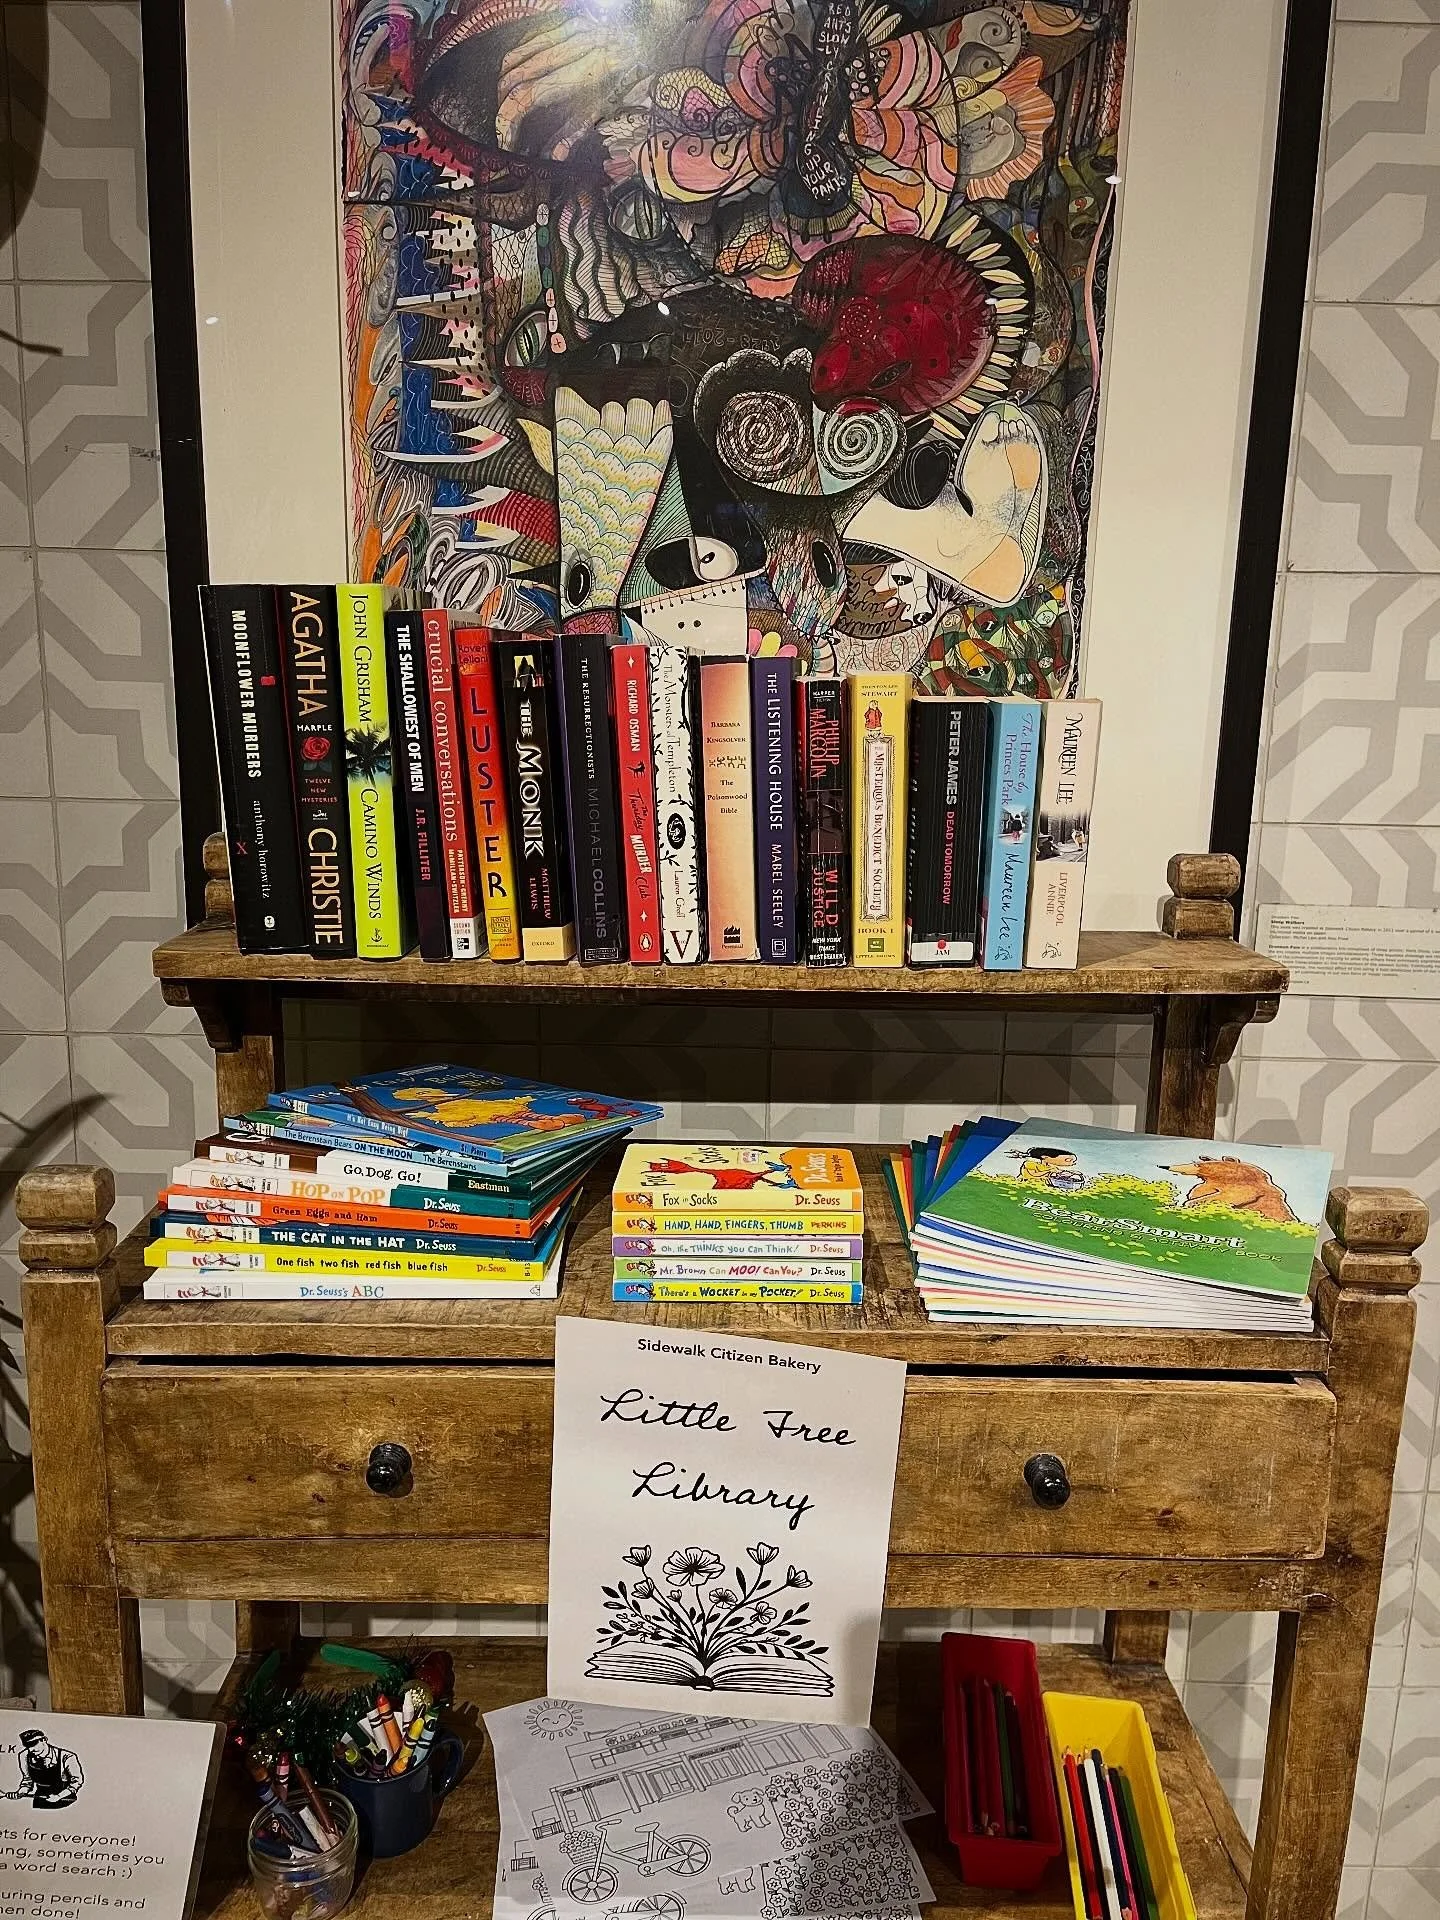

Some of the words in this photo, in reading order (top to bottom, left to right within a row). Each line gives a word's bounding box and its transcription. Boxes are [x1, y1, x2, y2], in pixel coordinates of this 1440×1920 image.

[348, 594, 369, 639] JOHN
[289, 591, 328, 716] AGATHA
[396, 625, 412, 651] THE
[426, 619, 452, 693] crucial
[231, 609, 255, 708] MOONFLOWER
[580, 657, 589, 679] THE
[353, 645, 373, 722] GRISHAM
[398, 653, 420, 742] SHALLOWEST
[626, 678, 639, 715] RICHARD
[767, 672, 778, 694] THE
[296, 724, 333, 732] MARPLE
[519, 698, 533, 738] THE
[582, 681, 595, 780] RESURRECTIONISTS
[629, 717, 641, 752] OSMAN
[767, 698, 782, 775] LISTENING
[948, 710, 962, 757] PETER
[242, 712, 262, 778] MURDERS
[407, 742, 422, 760] OF
[810, 708, 827, 778] MARGOLIN
[826, 719, 840, 766] PHILIP
[1003, 733, 1018, 777] Princes
[1018, 741, 1032, 780] House
[409, 762, 425, 792] MEN
[433, 700, 461, 842] conversations
[664, 737, 682, 793] Templeton
[946, 758, 959, 806] JAMES
[470, 686, 508, 898] LUSTER
[516, 737, 545, 860] MONK
[769, 781, 784, 831] HOUSE
[1001, 779, 1014, 805] Park
[253, 800, 266, 847] anthony
[360, 788, 379, 858] CAMINO
[415, 808, 426, 829] J.R.
[945, 811, 955, 843] DEAD
[418, 831, 431, 881] FILLITER
[630, 834, 653, 873] MURDER
[771, 843, 783, 884] MABEL
[258, 849, 272, 899] horowitz
[308, 828, 344, 944] CHRISTIE
[365, 862, 383, 919] WINDS
[673, 870, 684, 895] Lauren
[942, 844, 954, 905] TOMORROW
[999, 852, 1024, 912] Maureen
[592, 868, 607, 938] COLLINS
[772, 888, 784, 928] SEELEY
[813, 867, 825, 928] JUSTICE
[825, 869, 839, 928] WILD
[1055, 871, 1068, 927] LIVERPOOL
[999, 915, 1018, 940] Lee
[284, 1129, 298, 1140] The
[298, 1132, 333, 1145] Berenstain
[334, 1138, 352, 1149] Bears
[354, 1142, 367, 1152] ON
[368, 1145, 385, 1155] THE
[386, 1148, 413, 1160] MOON
[422, 1154, 436, 1164] The
[437, 1156, 477, 1171] Berenstains
[290, 1181, 330, 1200] HOP
[347, 1186, 386, 1204] POP
[423, 1198, 437, 1210] Dr.
[438, 1200, 461, 1213] Seuss
[343, 1164, 364, 1177] Go,
[365, 1166, 394, 1180] Dog.
[397, 1170, 422, 1183] Go!
[467, 1180, 510, 1193] Eastman
[272, 1205, 301, 1216] Green
[306, 1206, 331, 1219] Eggs
[334, 1210, 353, 1219] and
[355, 1213, 378, 1223] Ham
[427, 1218, 439, 1229] Dr.
[439, 1219, 459, 1230] Seuss
[662, 1192, 680, 1205] Fox
[689, 1192, 718, 1207] Socks
[794, 1194, 812, 1206] Dr.
[813, 1194, 841, 1206] Seuss
[271, 1231, 296, 1243] THE
[301, 1231, 327, 1245] CAT
[331, 1235, 346, 1245] IN
[350, 1237, 372, 1247] THE
[377, 1236, 406, 1249] HAT
[415, 1238, 431, 1250] Dr.
[431, 1240, 457, 1251] Seuss
[664, 1219, 691, 1231] HAND,
[694, 1219, 723, 1231] HAND,
[725, 1219, 768, 1230] FINGERS,
[769, 1220, 804, 1231] THUMB
[810, 1221, 847, 1229] PERKINS
[276, 1257, 294, 1267] One
[297, 1257, 315, 1268] fish
[320, 1258, 338, 1268] two
[341, 1259, 360, 1269] fish
[365, 1260, 382, 1269] red
[383, 1260, 401, 1270] fish
[407, 1260, 428, 1271] blue
[430, 1261, 448, 1272] fish
[476, 1264, 487, 1273] Dr.
[488, 1264, 507, 1273] Seuss
[727, 1245, 745, 1254] you
[766, 1243, 800, 1254] Think!
[809, 1244, 823, 1253] Dr.
[823, 1245, 844, 1254] Seuss
[1235, 1250, 1283, 1262] BOOK
[659, 1267, 675, 1275] Mr.
[677, 1265, 707, 1275] Brown
[709, 1266, 726, 1275] Can
[728, 1265, 760, 1276] MOO!
[763, 1266, 780, 1276] Can
[780, 1266, 803, 1276] You?
[810, 1266, 824, 1276] Dr.
[824, 1266, 846, 1276] Seuss
[299, 1286, 315, 1296] Dr.
[316, 1285, 348, 1297] Seuss's
[351, 1285, 385, 1298] ABC
[658, 1286, 689, 1297] There's
[699, 1287, 740, 1297] WOCKET
[758, 1286, 804, 1298] POCKET!
[809, 1289, 823, 1298] Dr.
[823, 1288, 845, 1298] Seuss
[637, 1338, 706, 1358] Sidewalk
[709, 1347, 763, 1365] Citizen
[767, 1355, 823, 1376] Bakery
[600, 1388, 738, 1432] Little
[762, 1410, 857, 1446] Free
[631, 1461, 816, 1531] Library
[23, 1828, 48, 1841] for
[51, 1831, 136, 1847] everyone!
[37, 1848, 129, 1863] sometimes
[134, 1855, 165, 1866] you
[13, 1862, 57, 1873] word
[62, 1864, 116, 1877] search
[31, 1906, 80, 1920] done!
[50, 1894, 109, 1907] pencils
[114, 1898, 146, 1909] and
